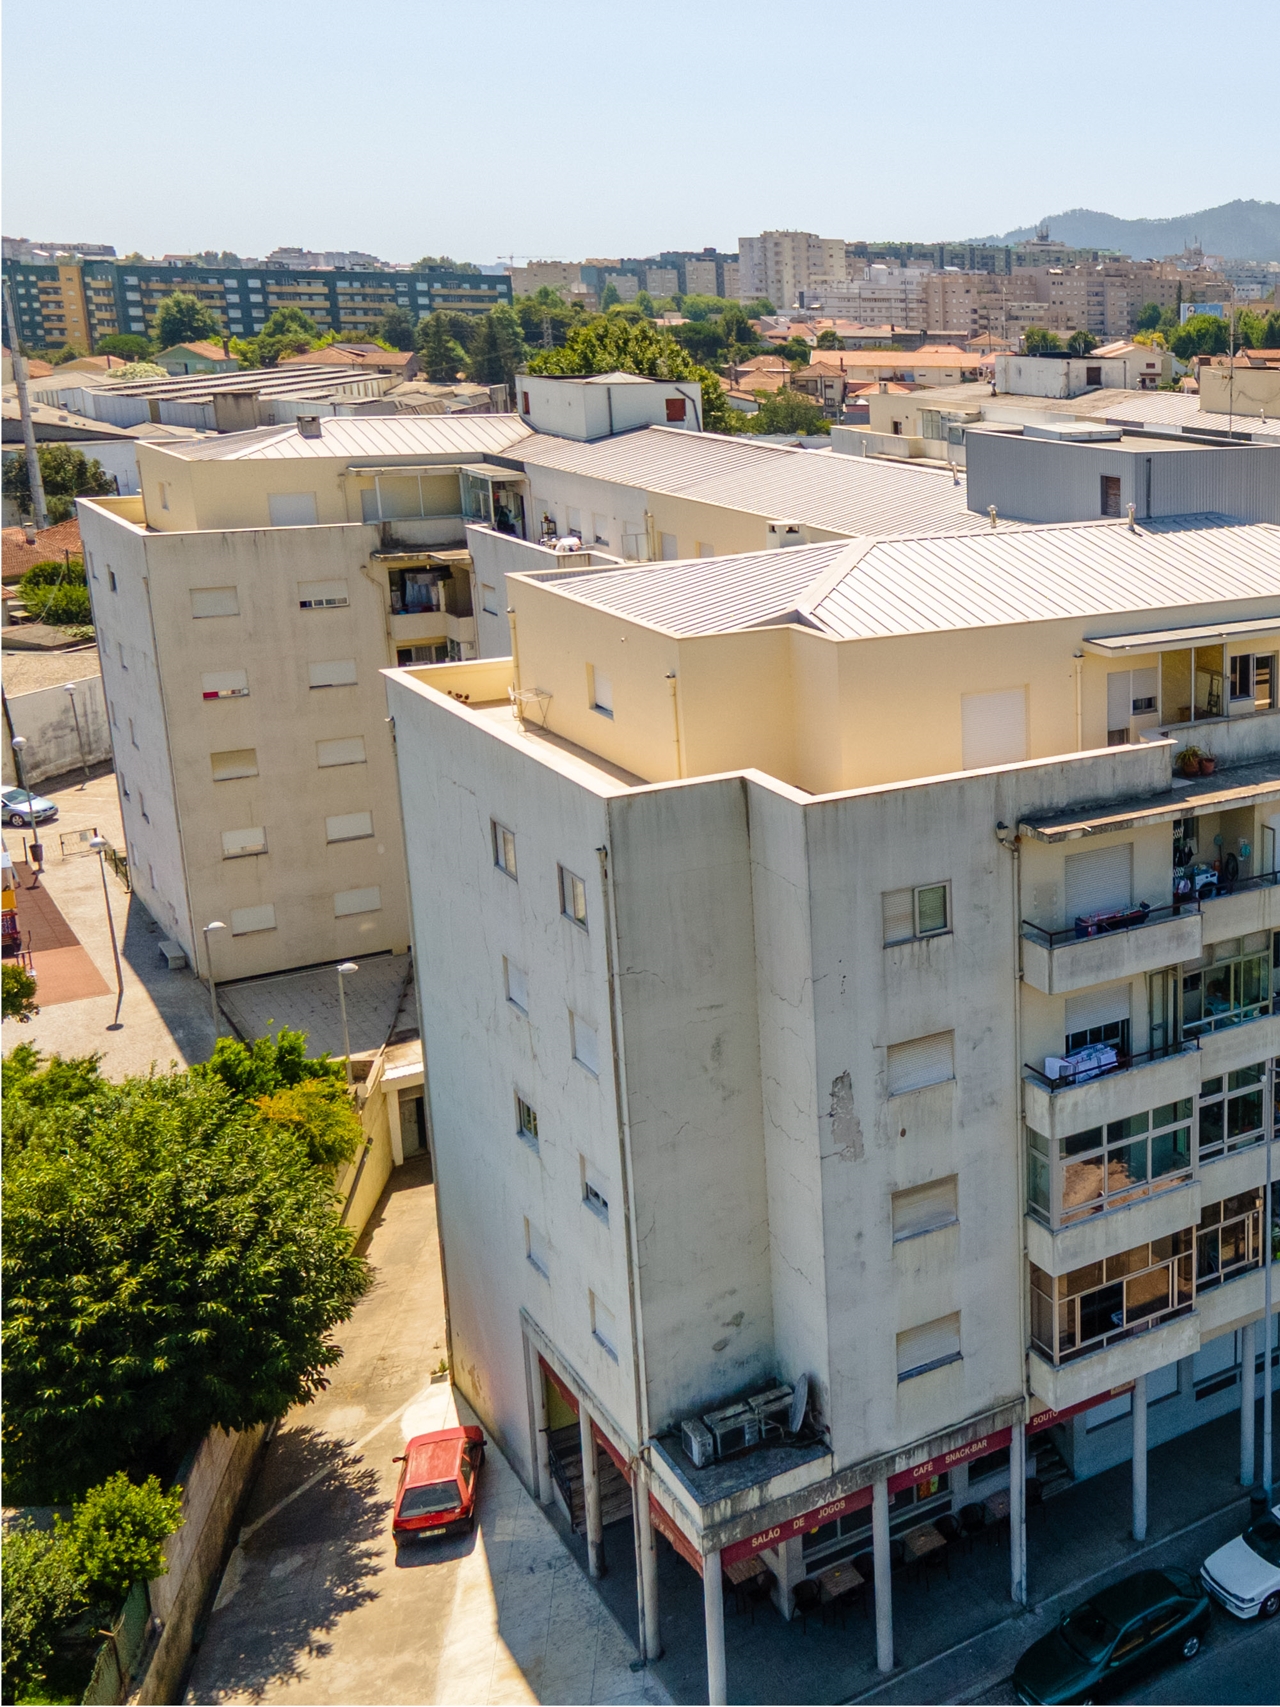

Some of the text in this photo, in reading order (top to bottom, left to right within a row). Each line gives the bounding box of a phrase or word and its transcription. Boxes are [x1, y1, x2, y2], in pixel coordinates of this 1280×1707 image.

[1033, 1411, 1059, 1426] SOUTO
[913, 1439, 988, 1477] CAFÉ SNACK-BAR
[751, 1500, 846, 1547] SALÃO DE JOGOS
